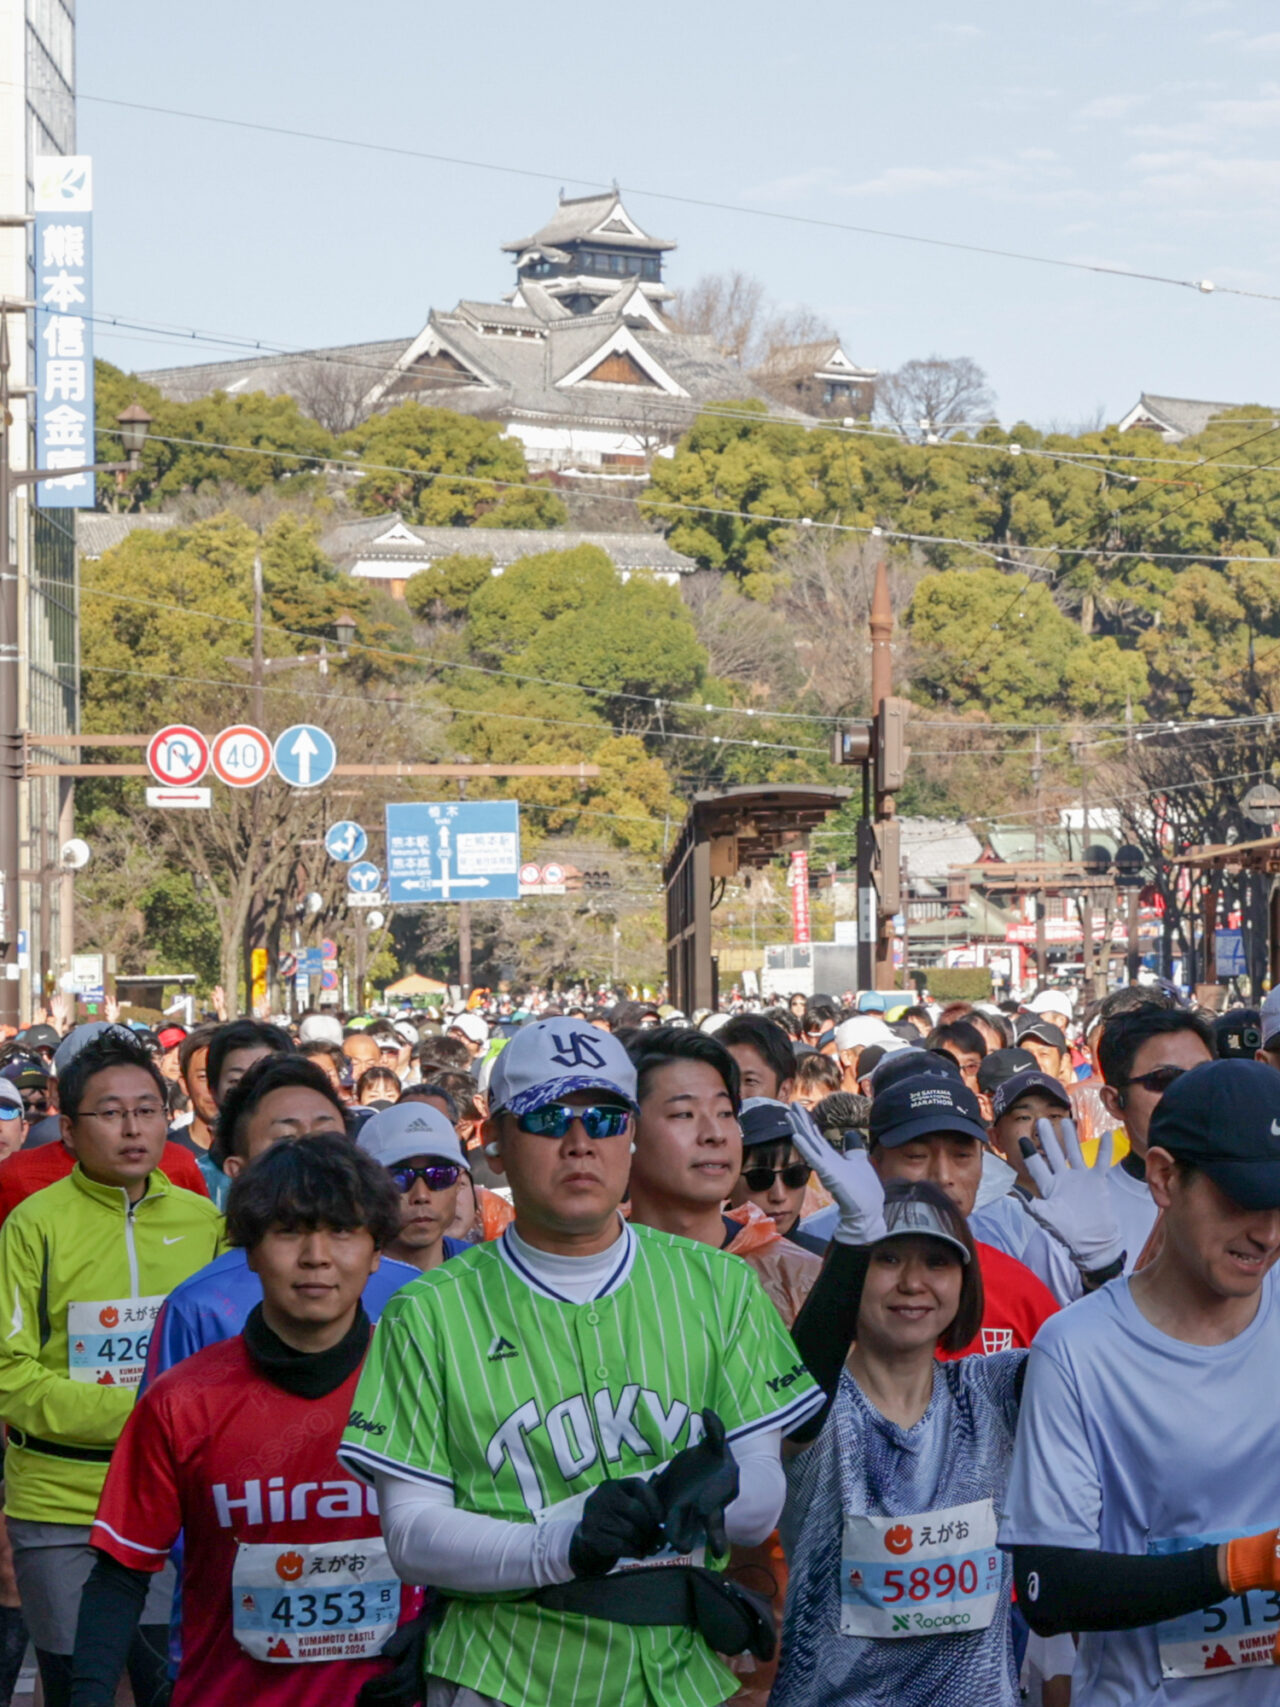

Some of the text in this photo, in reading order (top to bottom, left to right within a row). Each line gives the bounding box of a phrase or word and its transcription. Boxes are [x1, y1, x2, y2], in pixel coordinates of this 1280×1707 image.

[42, 223, 86, 490] 熊本信用金庫
[226, 744, 257, 768] 40
[911, 1099, 953, 1109] MARATHON
[124, 1306, 160, 1322] えがお
[97, 1335, 149, 1362] 426
[919, 1520, 969, 1547] えがお
[309, 1553, 367, 1575] えがお
[988, 1557, 996, 1570] B
[882, 1559, 978, 1602] 5890
[380, 1589, 391, 1602] B
[271, 1591, 366, 1627] 4353
[913, 1612, 971, 1630] Rococo
[299, 1631, 375, 1646] KUMAMOTO CASTLE
[299, 1645, 366, 1657] MARATHON 2024
